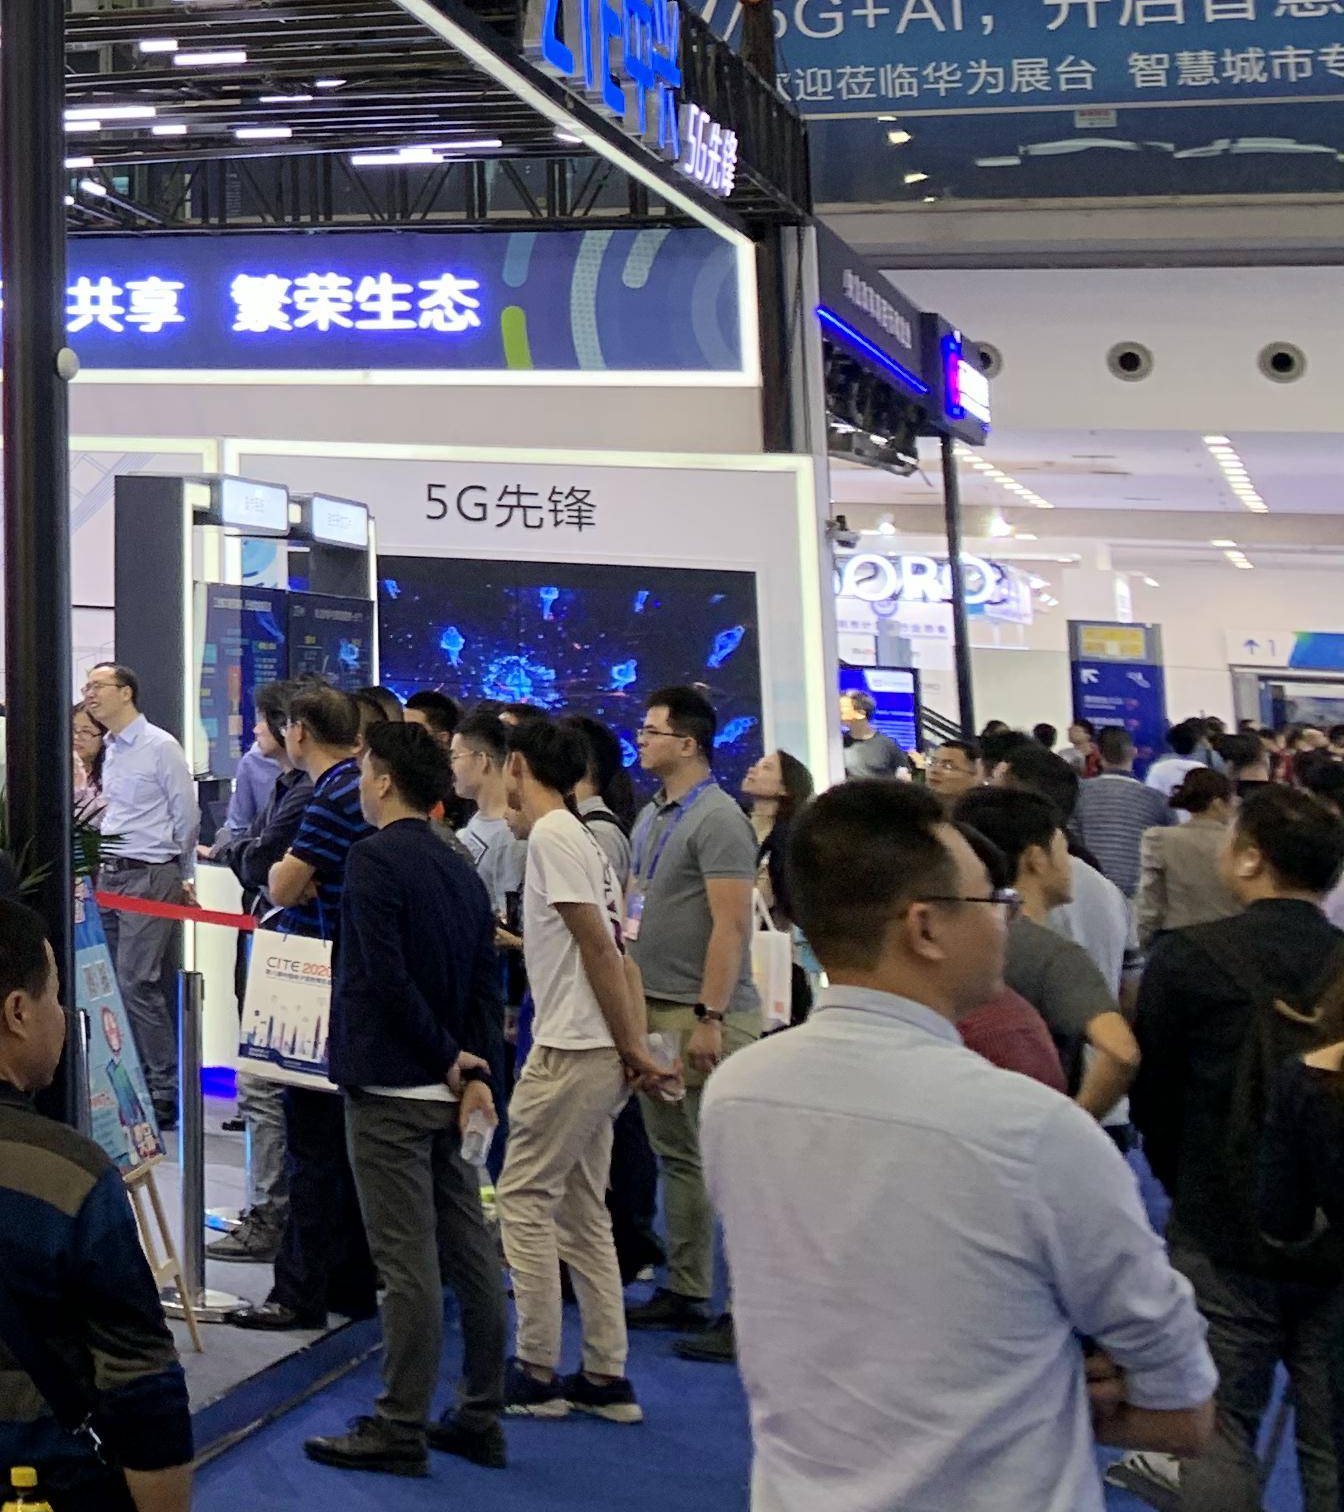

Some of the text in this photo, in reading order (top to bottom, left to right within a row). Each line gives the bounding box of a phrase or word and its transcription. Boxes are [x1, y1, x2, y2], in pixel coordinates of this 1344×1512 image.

[684, 103, 738, 196] 5G先锋
[230, 271, 482, 333] 繁荣生态
[425, 483, 598, 532] 5G先锋
[267, 956, 301, 973] CITE
